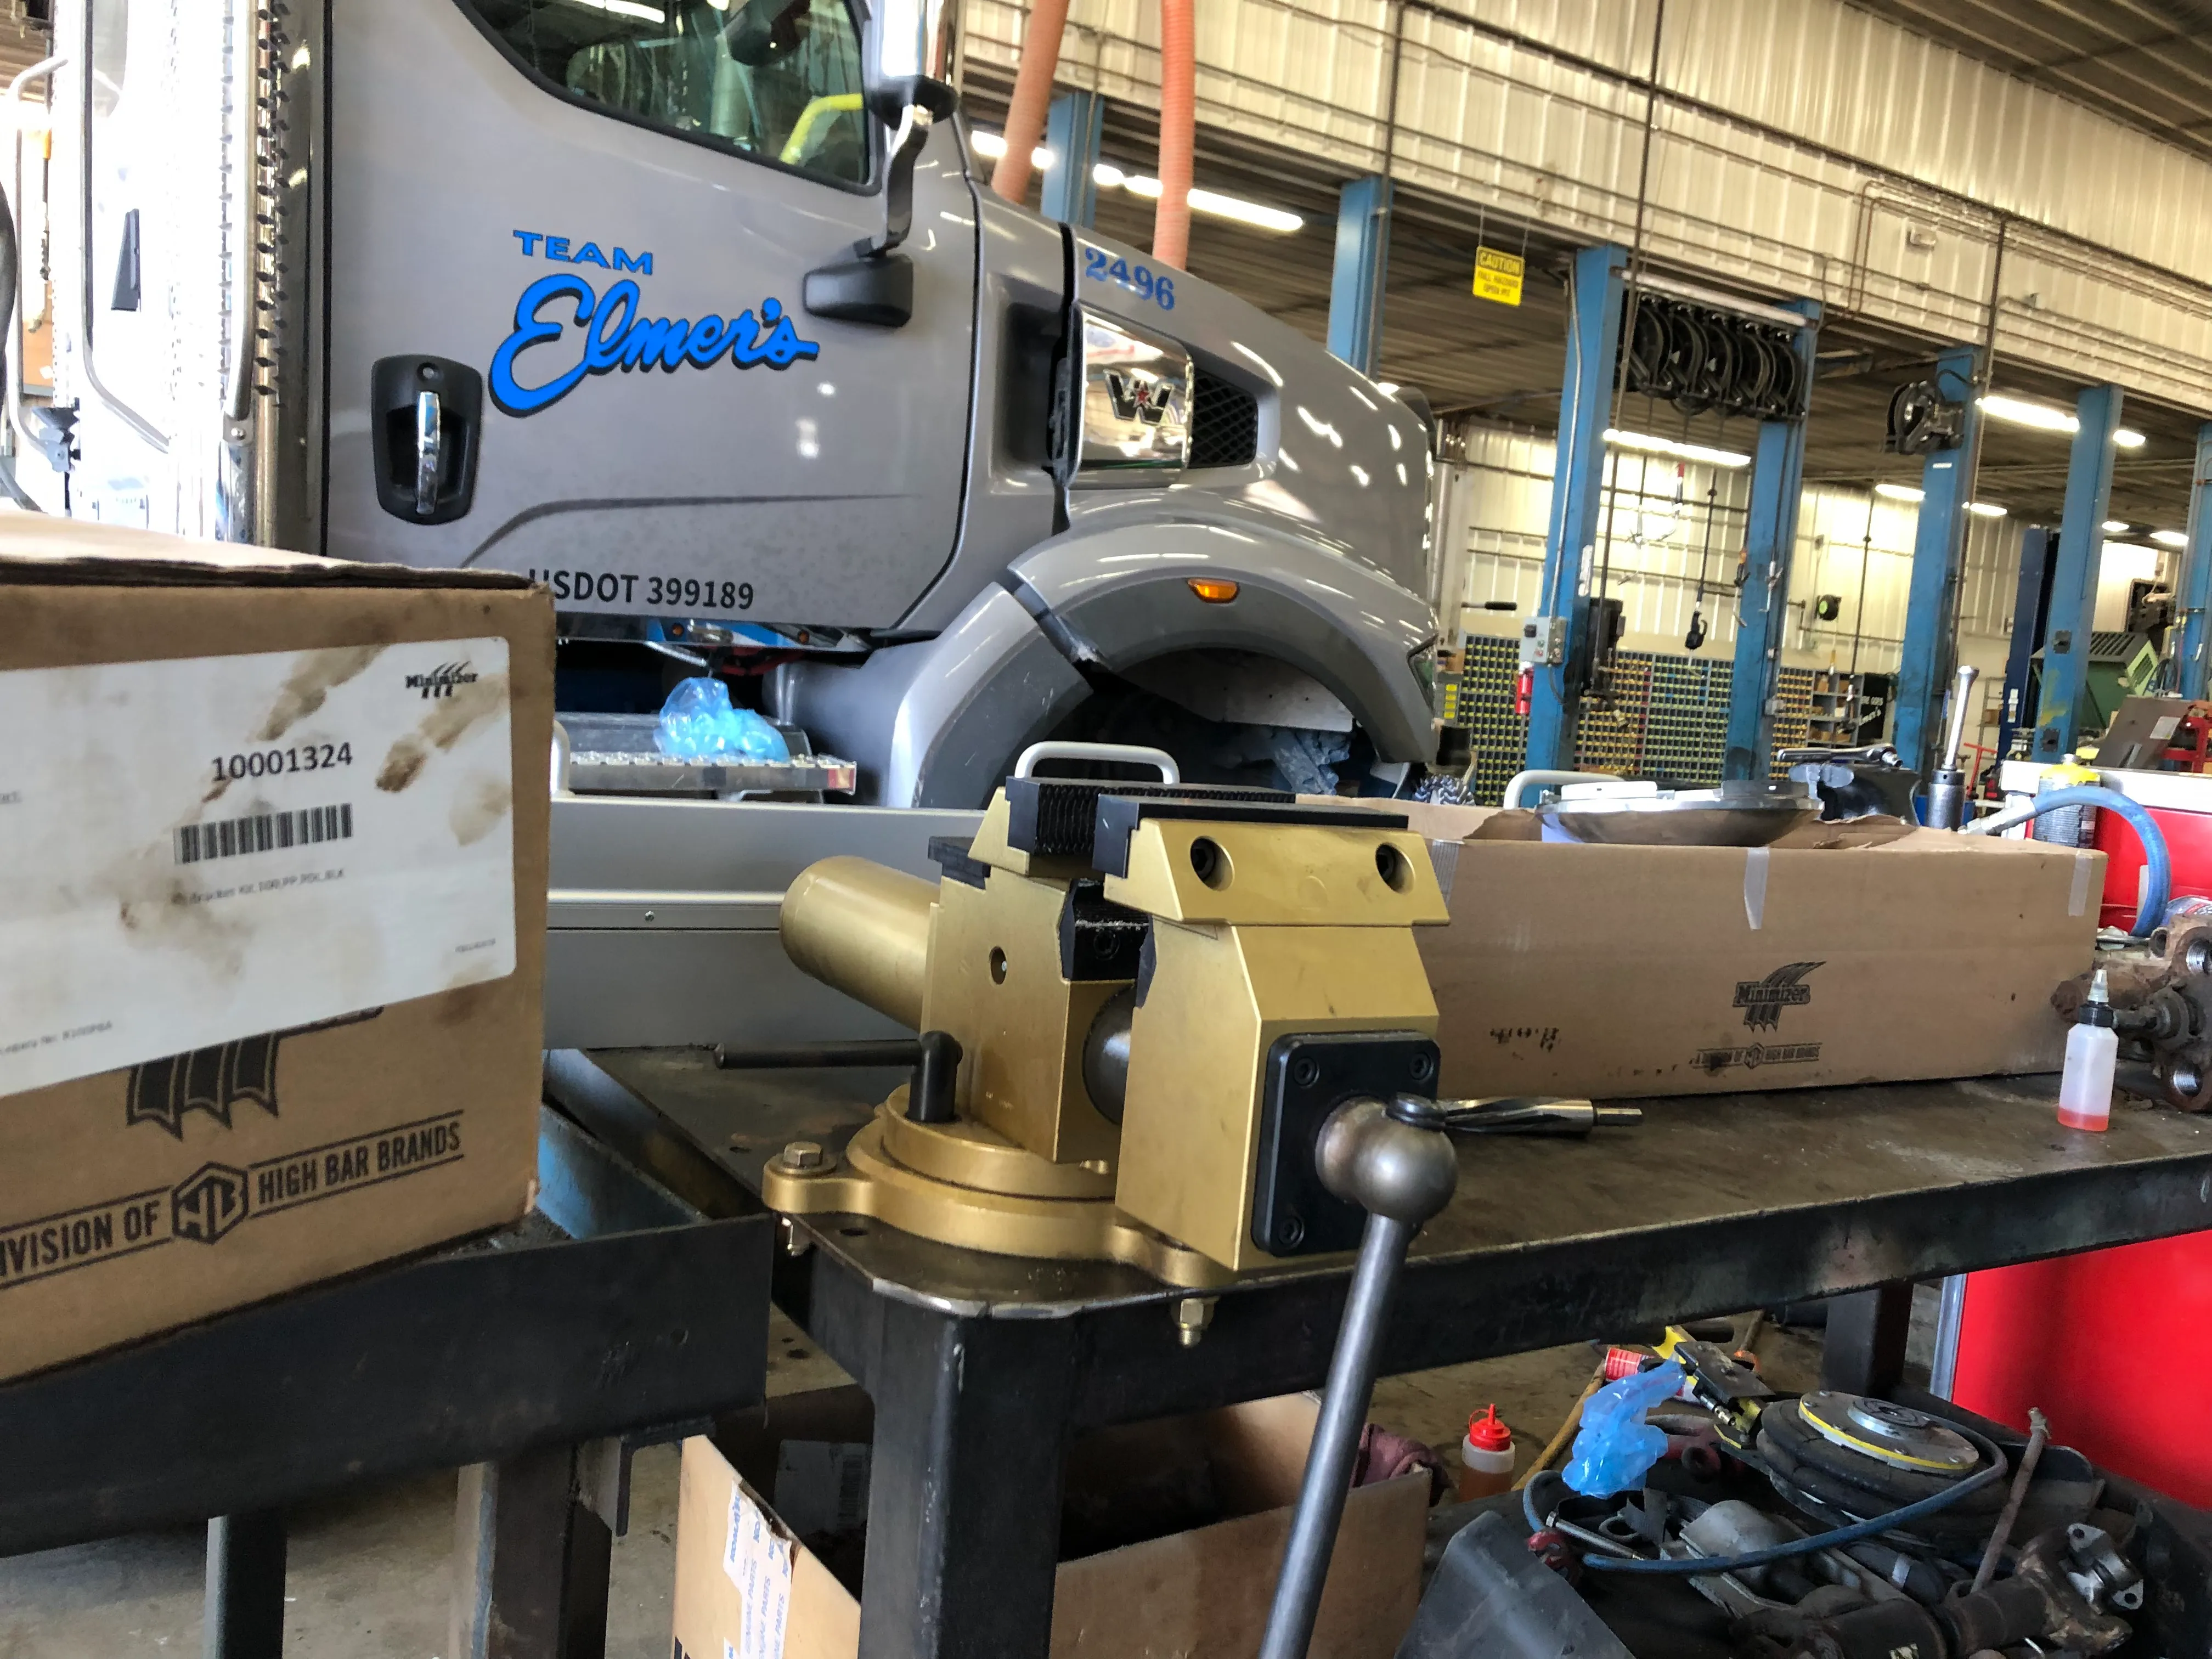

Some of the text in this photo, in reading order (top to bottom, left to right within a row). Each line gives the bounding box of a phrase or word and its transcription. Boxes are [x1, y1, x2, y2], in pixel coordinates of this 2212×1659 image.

[513, 229, 653, 275] TEAM
[1480, 252, 1520, 275] CAUTION
[1084, 246, 1175, 311] 2496
[488, 273, 820, 418] Elmer's
[646, 576, 754, 610] 399189
[212, 741, 353, 782] 10001324
[0, 1212, 113, 1277] IVISION
[123, 1200, 161, 1241] OF
[257, 1158, 317, 1205] HIGH
[324, 1144, 369, 1187] BAR
[376, 1120, 462, 1172] BRANDS
[761, 1576, 771, 1617] PARTS
[775, 1593, 785, 1636] PARTS
